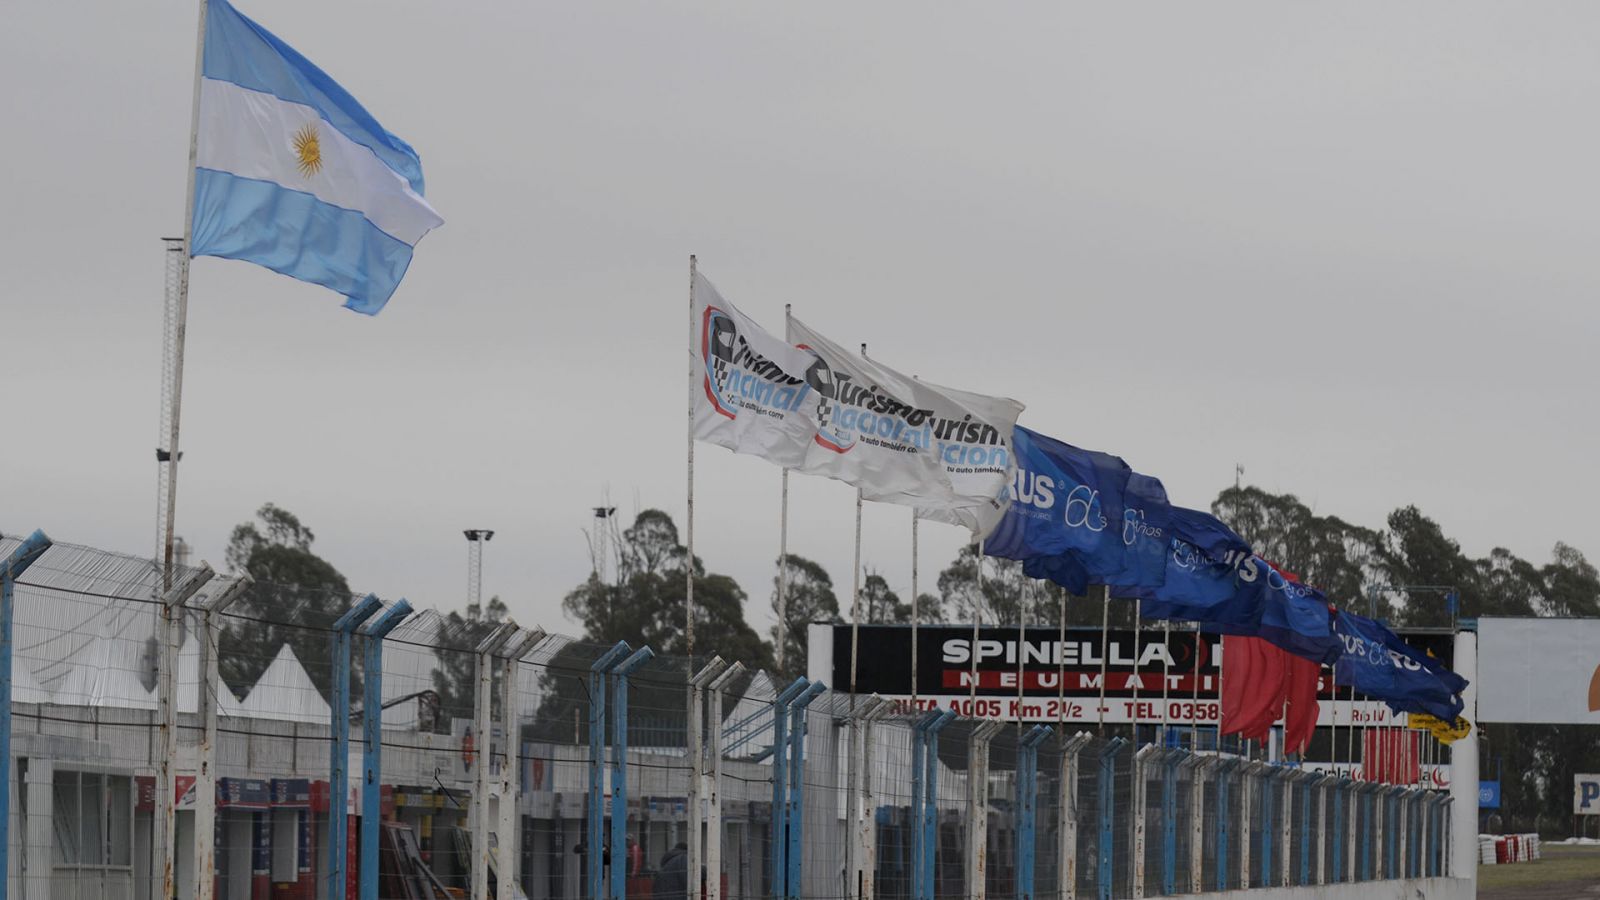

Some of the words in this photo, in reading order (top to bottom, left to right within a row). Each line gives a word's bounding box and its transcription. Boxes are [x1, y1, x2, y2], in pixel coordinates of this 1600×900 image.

[866, 437, 880, 446] auto
[955, 466, 973, 474] auto
[943, 639, 1176, 666] SPINELLA
[1009, 700, 1042, 718] Km
[1124, 702, 1163, 719] TEL.
